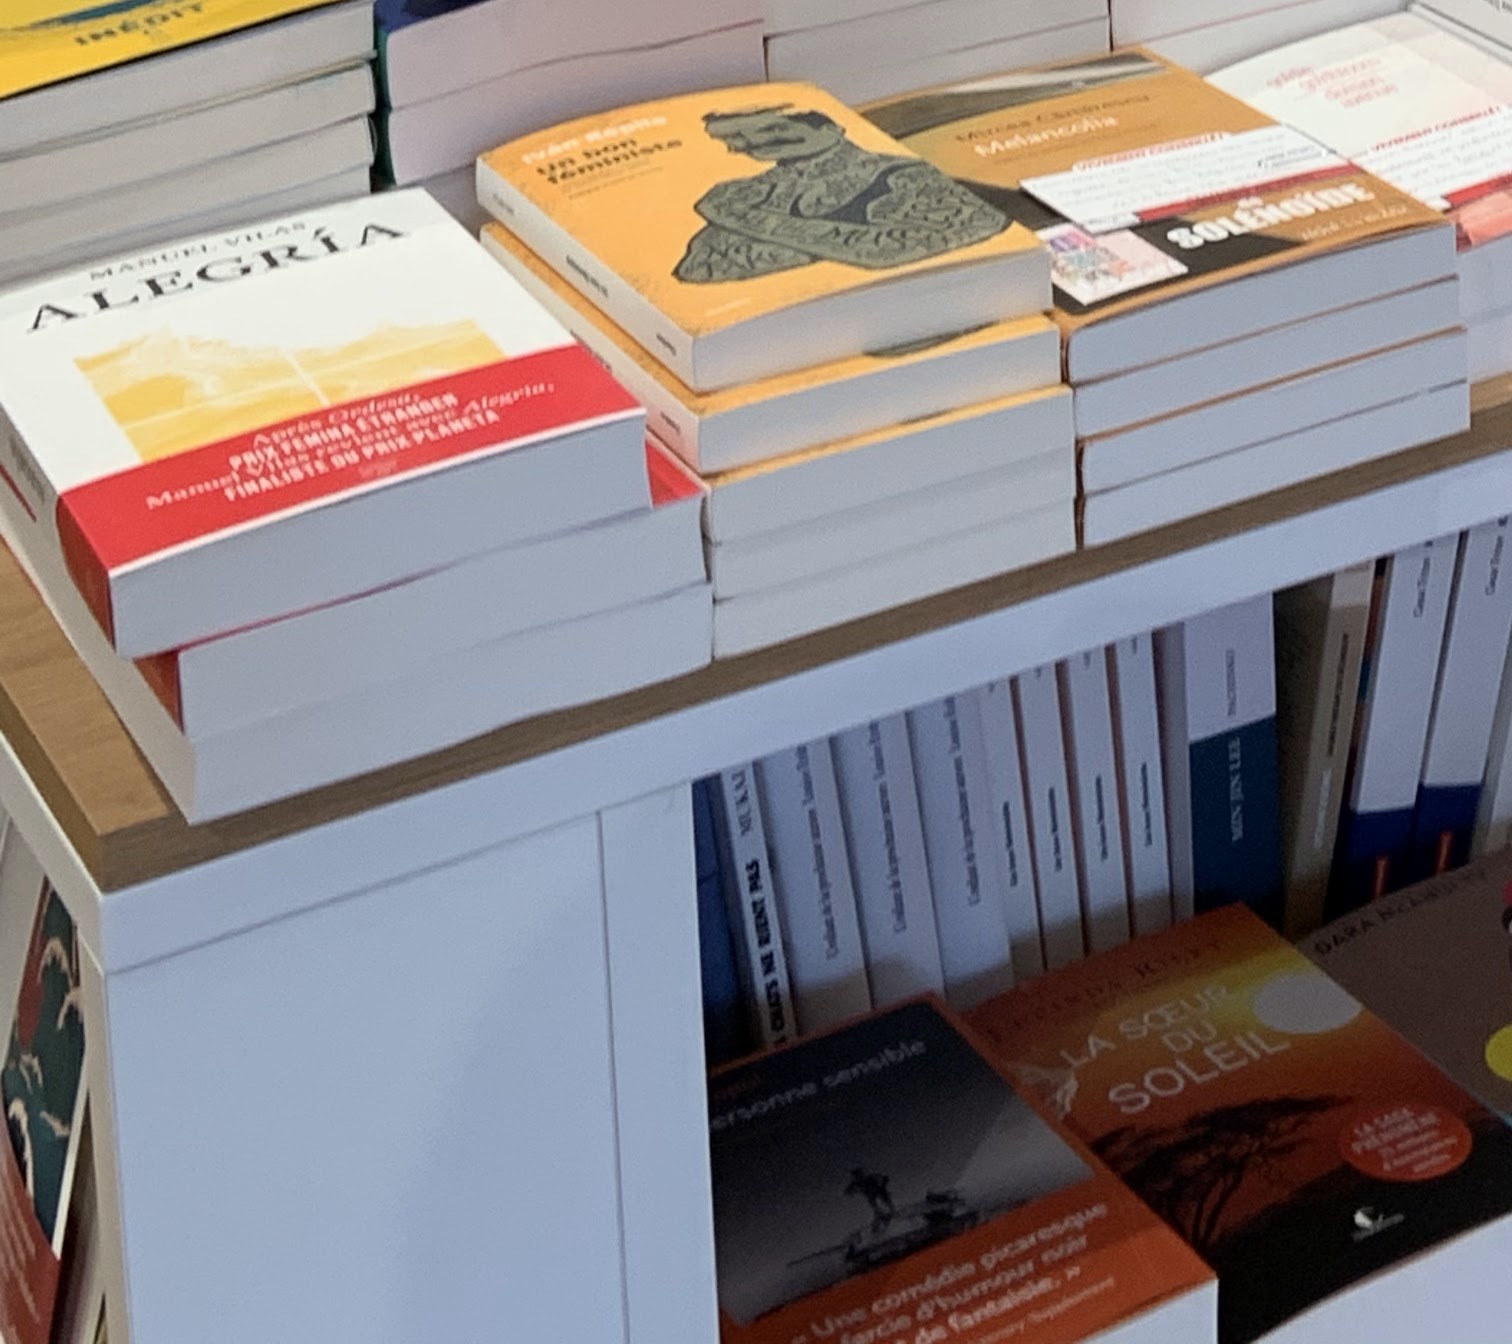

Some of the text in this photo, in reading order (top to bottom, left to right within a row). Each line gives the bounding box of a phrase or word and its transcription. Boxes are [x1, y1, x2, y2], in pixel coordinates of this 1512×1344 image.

[536, 138, 638, 176] Un bon
[547, 139, 683, 184] féministe
[27, 223, 410, 334] ALEGRÍA
[224, 409, 502, 503] FINALISTE DU PRIX PLANETA
[229, 419, 355, 471] PRIX FEMINA
[1059, 1033, 1117, 1070] LA
[1117, 982, 1229, 1042] SŒUR
[1161, 1019, 1219, 1055] DU
[822, 1038, 928, 1089] sensible
[1107, 1028, 1292, 1115] SOLEIL
[872, 1261, 978, 1314] comédie
